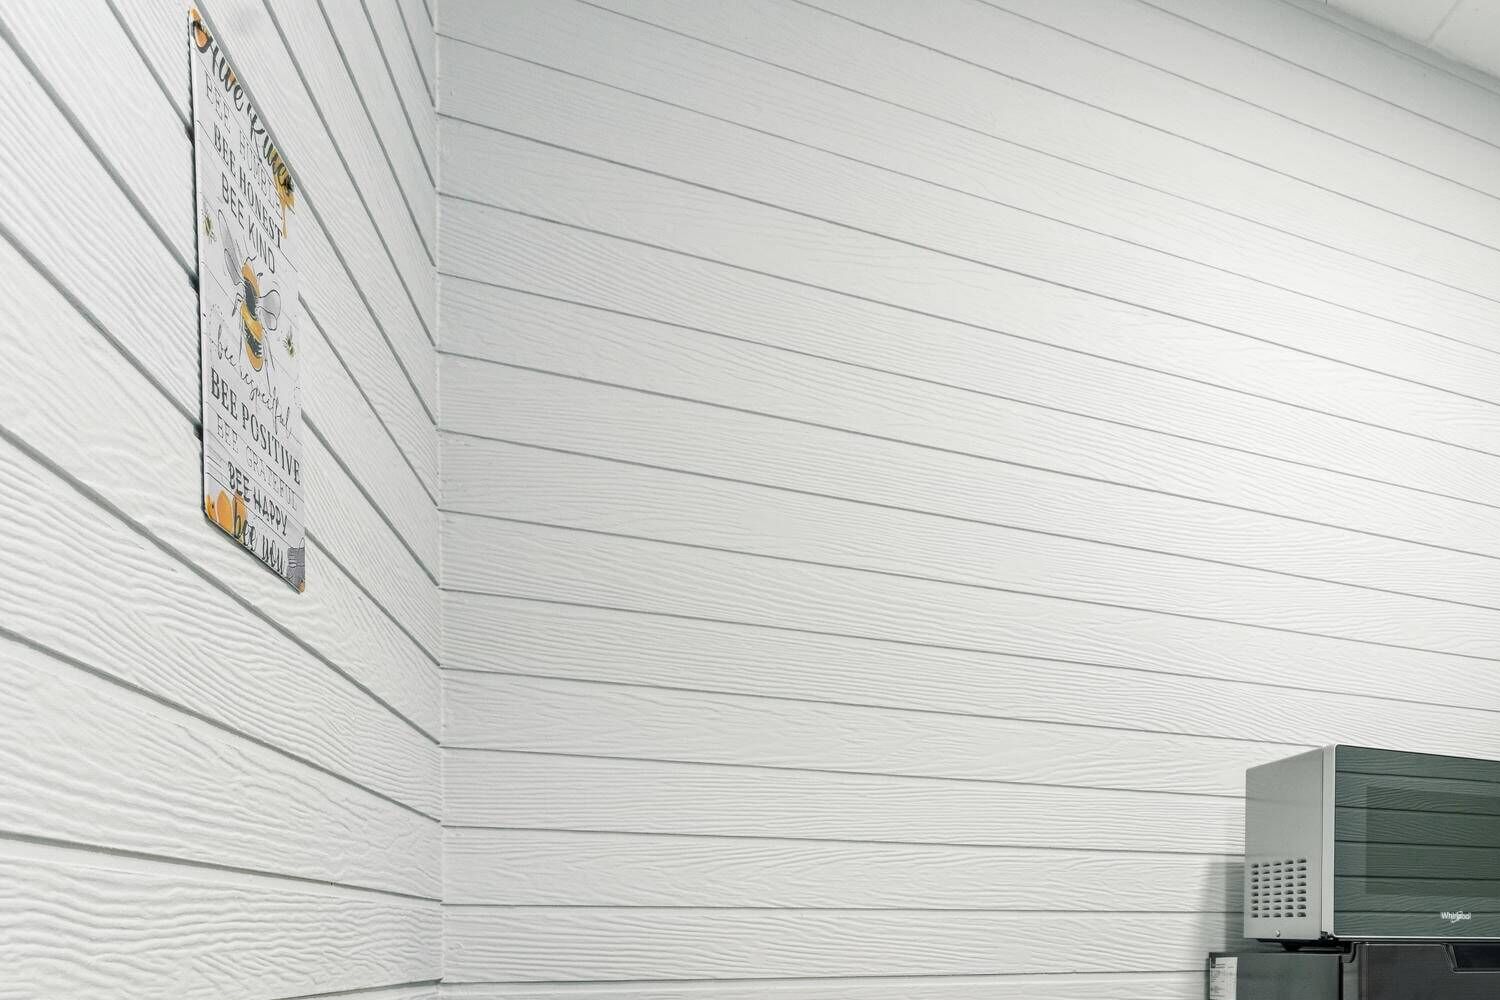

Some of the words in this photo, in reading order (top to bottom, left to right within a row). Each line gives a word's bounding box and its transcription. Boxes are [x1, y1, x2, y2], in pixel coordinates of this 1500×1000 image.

[205, 70, 231, 134] BEE
[214, 121, 236, 178] BEE
[240, 165, 283, 251] HONEST
[221, 171, 245, 230] BEE
[248, 214, 275, 274] KIND
[211, 365, 238, 421] BEE
[242, 402, 301, 486] POSITIVE
[216, 413, 239, 455] BEE
[228, 461, 250, 503] BEE
[253, 486, 287, 536] HAPPY
[1441, 911, 1472, 922] Whirlpool
